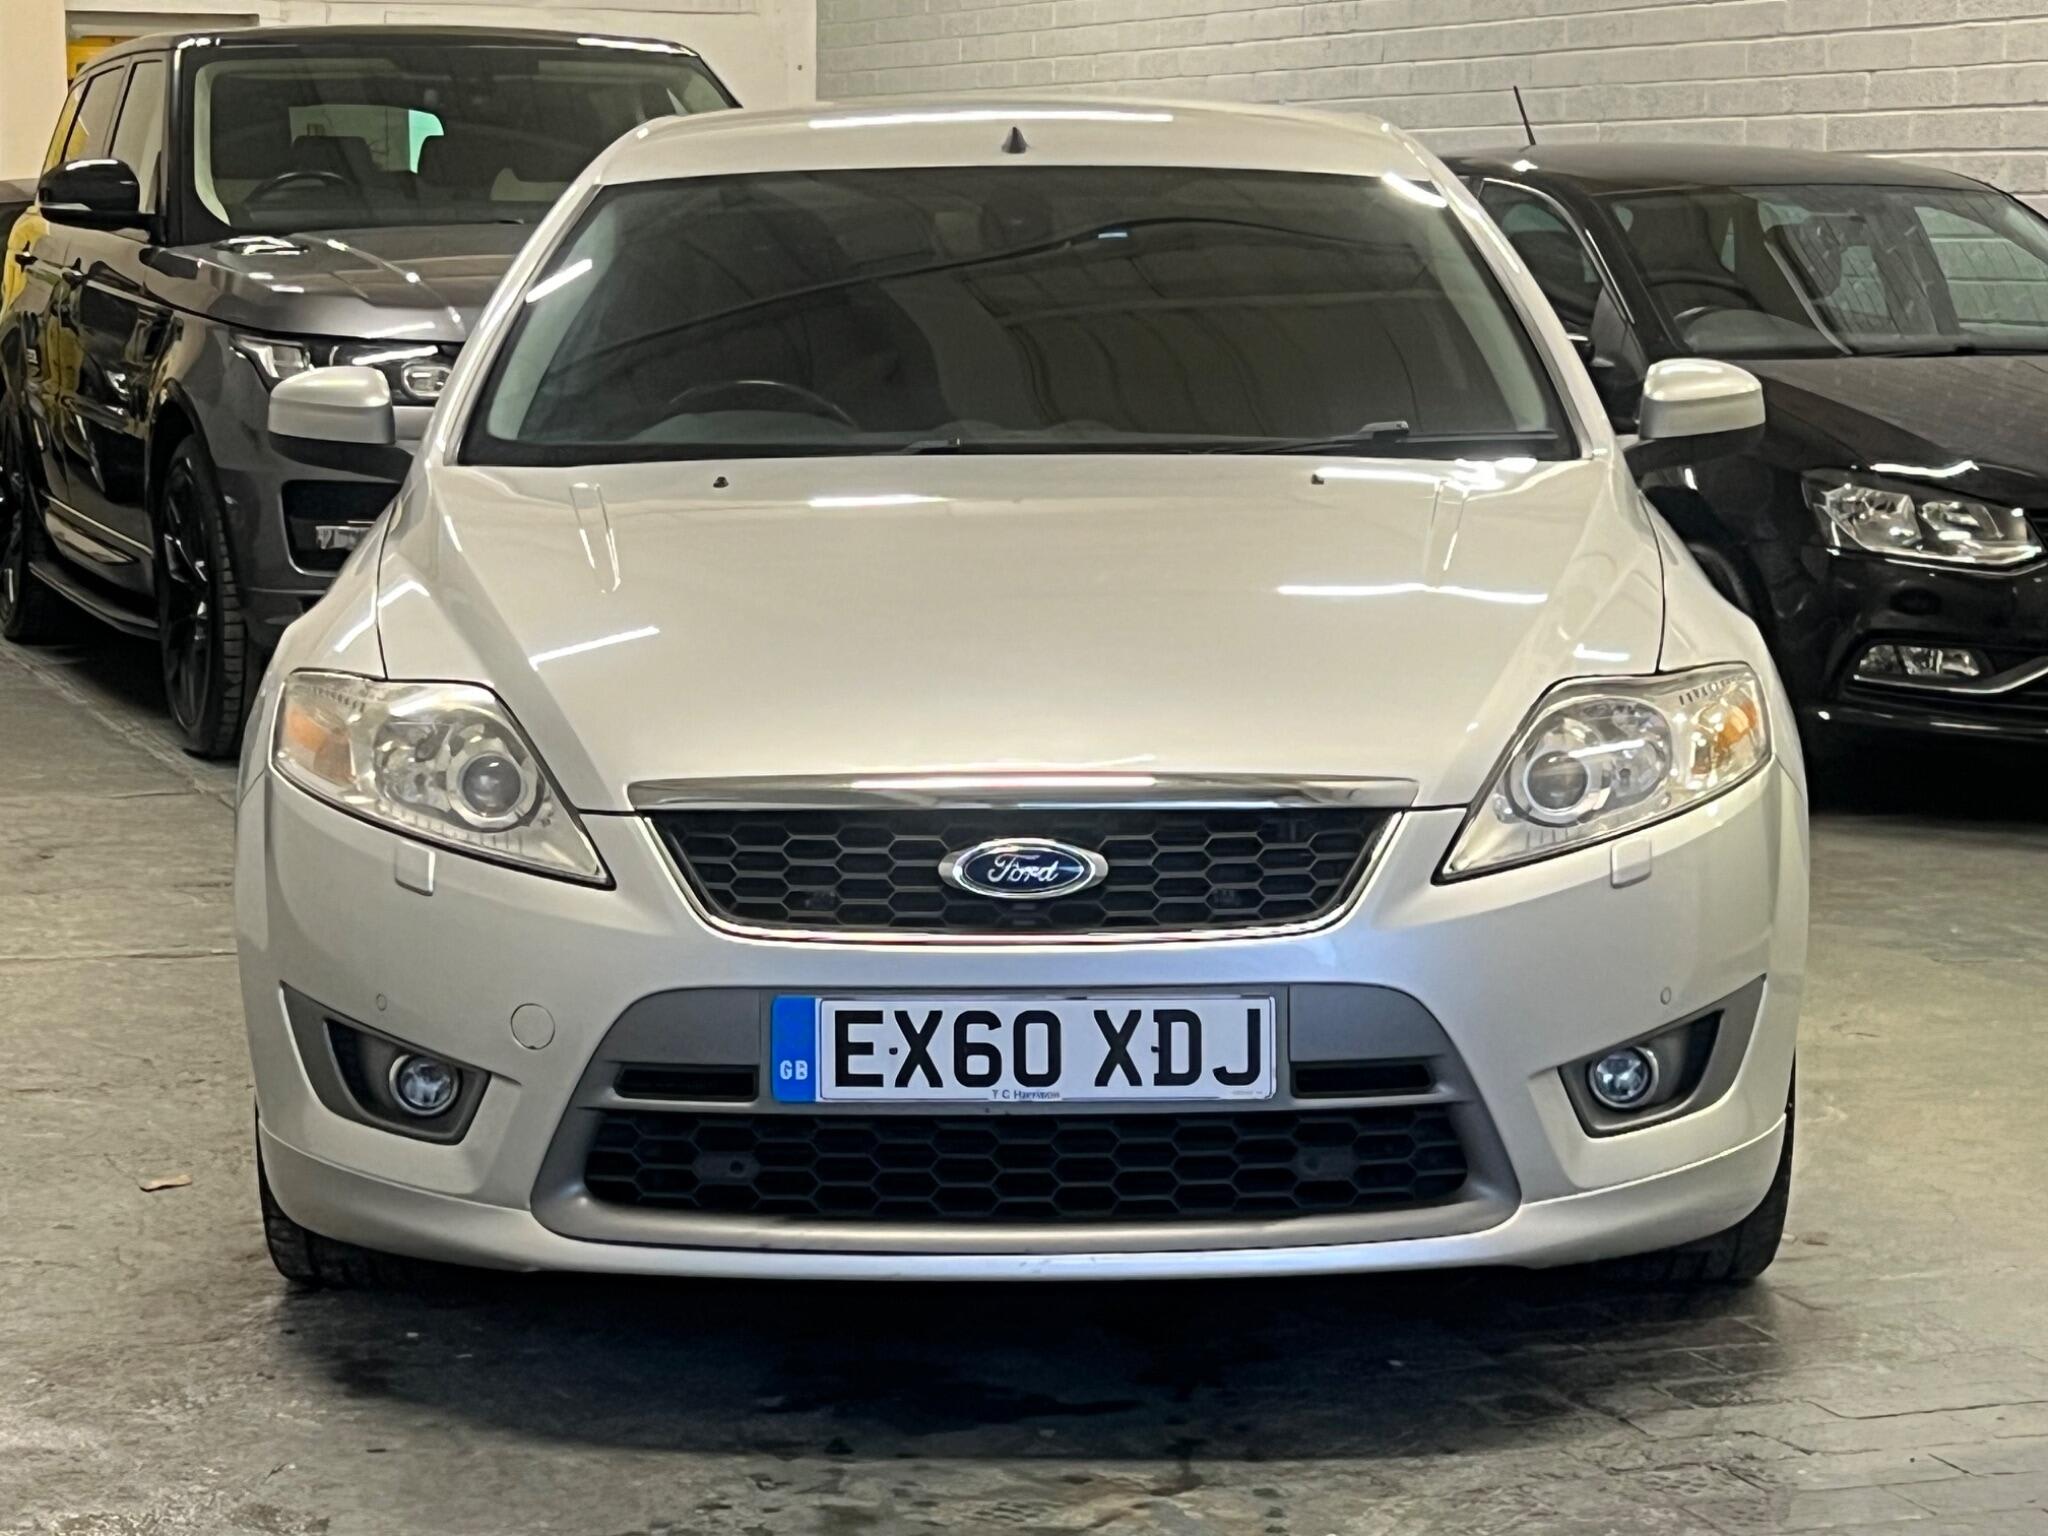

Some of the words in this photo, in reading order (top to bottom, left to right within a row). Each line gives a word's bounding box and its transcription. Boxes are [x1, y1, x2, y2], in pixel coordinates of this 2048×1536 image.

[987, 853, 1060, 883] Ford
[834, 1009, 1062, 1088] EX60
[1093, 1008, 1261, 1087] XDJ
[780, 1059, 808, 1080] GB
